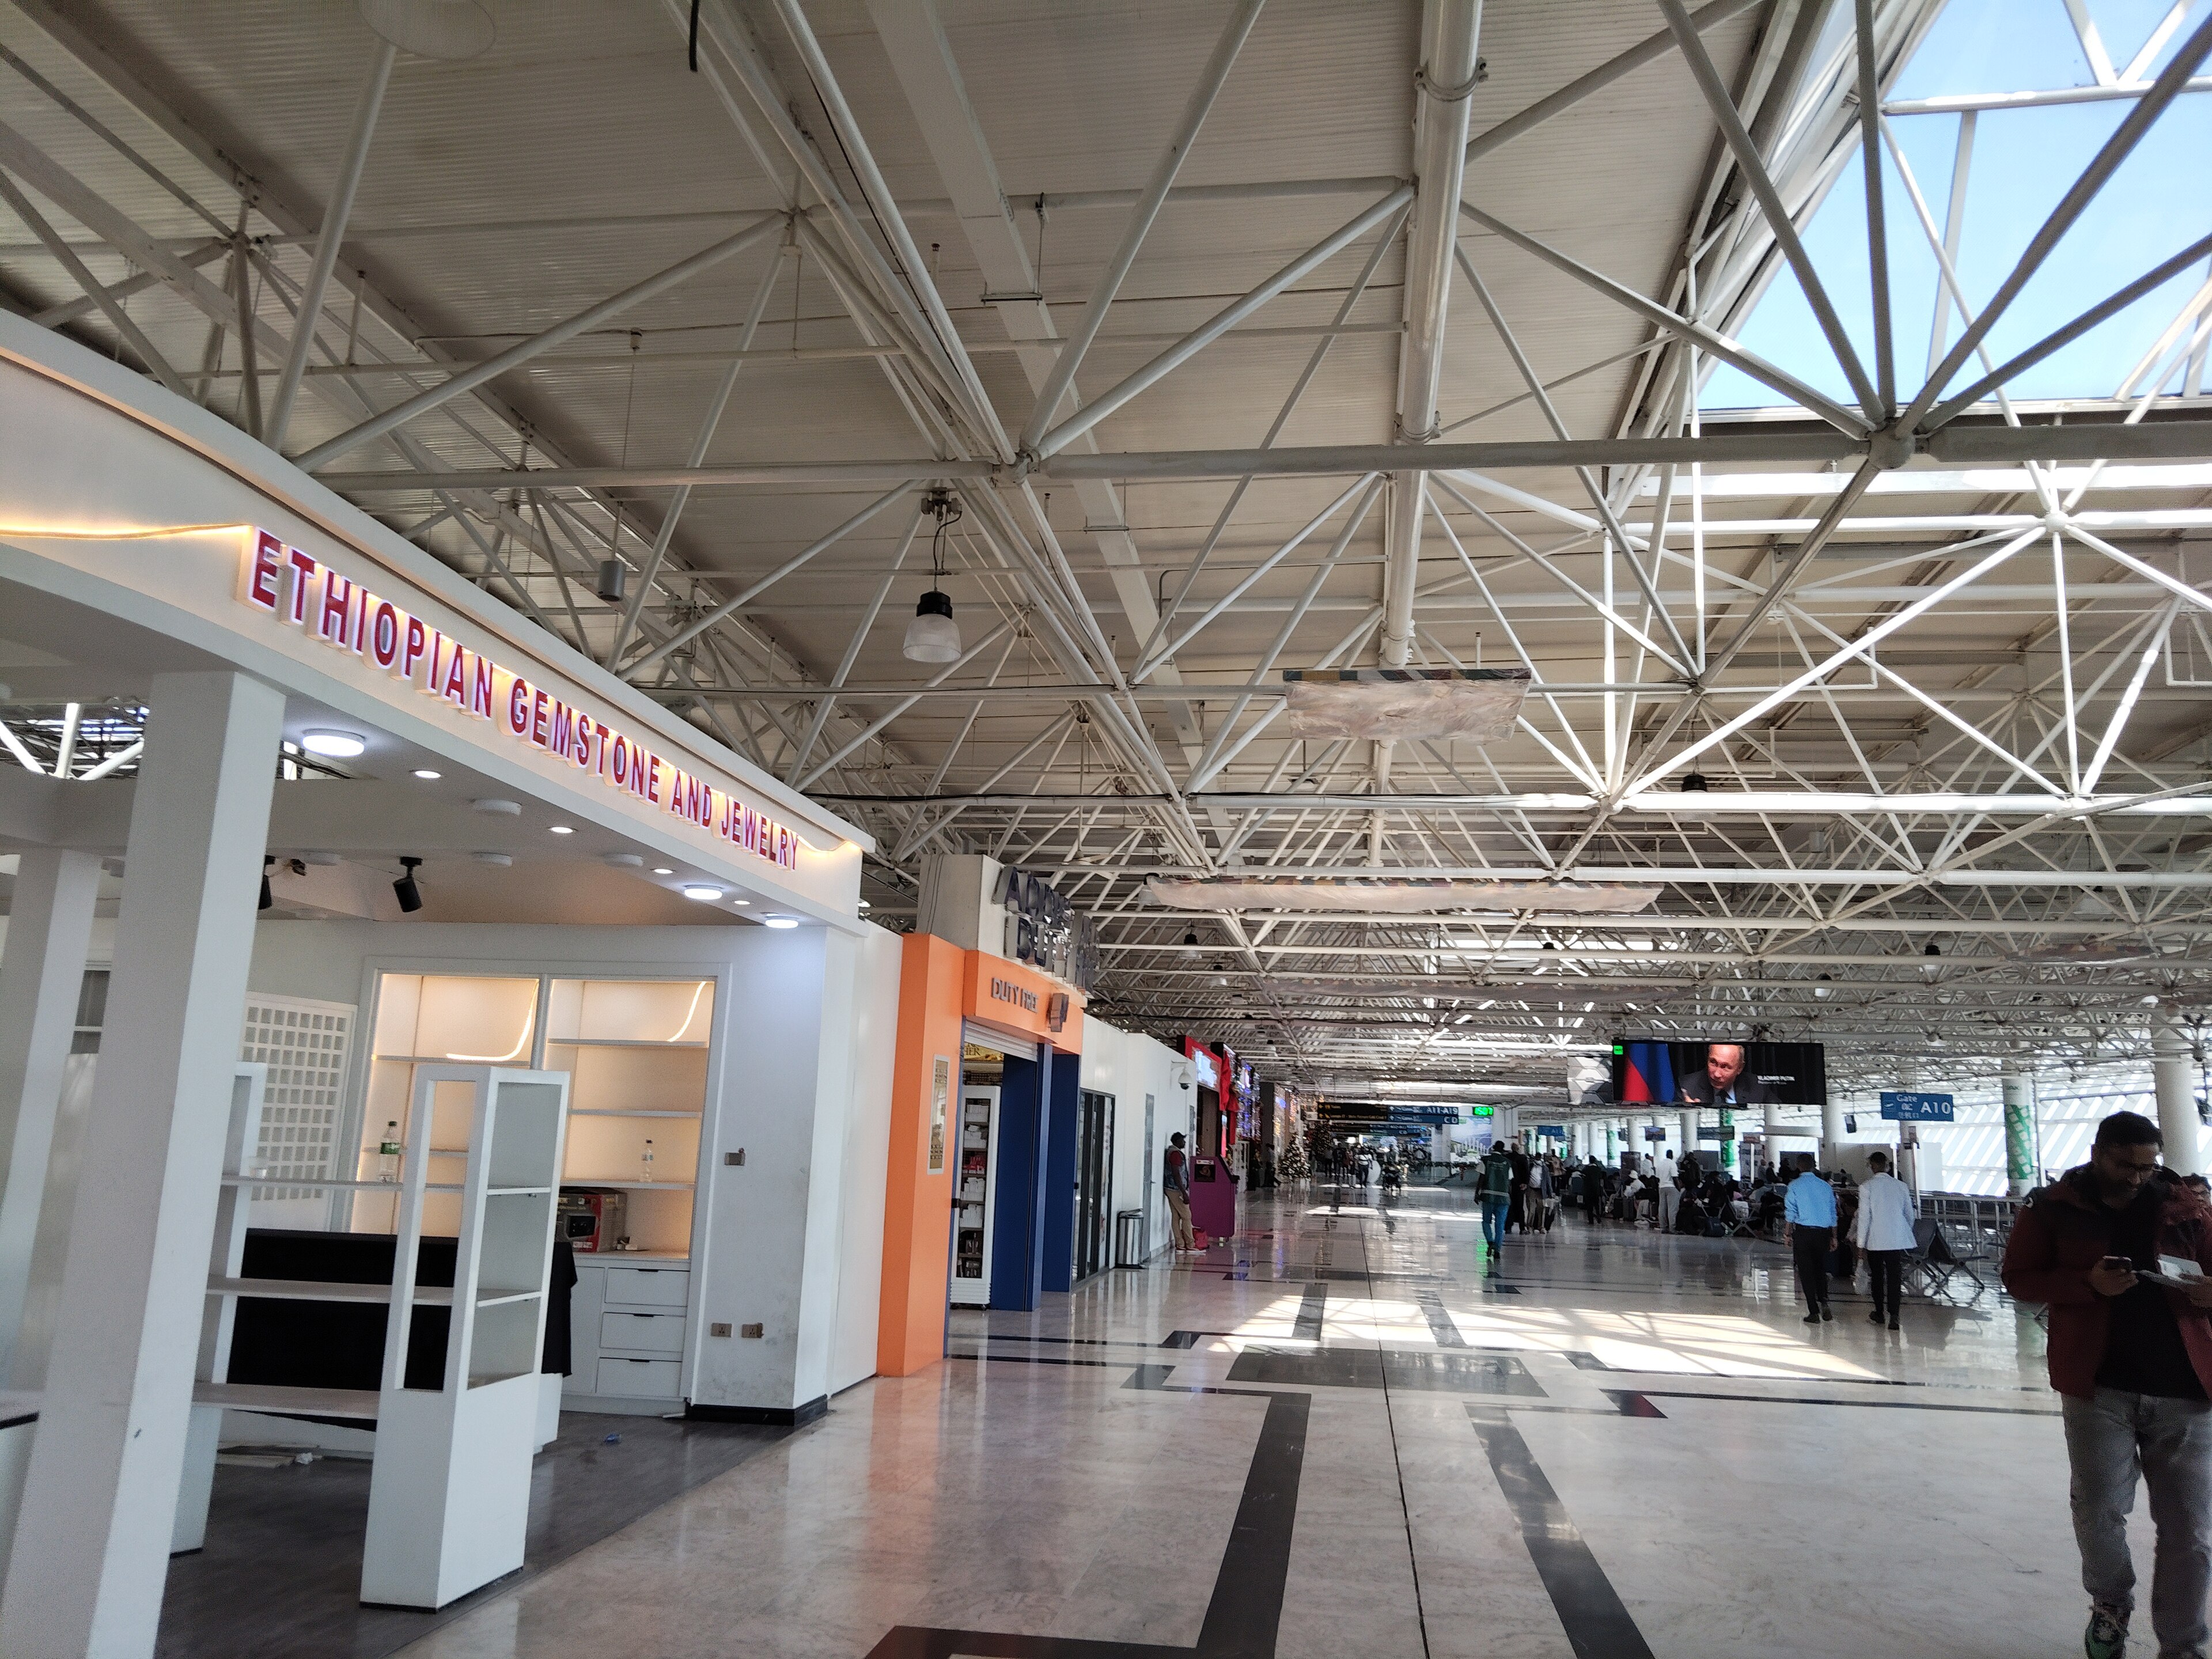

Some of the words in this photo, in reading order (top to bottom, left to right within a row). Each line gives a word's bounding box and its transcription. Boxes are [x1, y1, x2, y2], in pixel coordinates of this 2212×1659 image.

[248, 526, 494, 720] ETHIOPIAN
[510, 677, 660, 805] GEMSTONE
[671, 767, 712, 829] AND
[720, 794, 799, 871] JEWELRY
[992, 978, 1019, 1004] DUTY
[1896, 1094, 1918, 1103] Gate
[1426, 1107, 1459, 1115] A11-A19
[1920, 1101, 1951, 1115] A10
